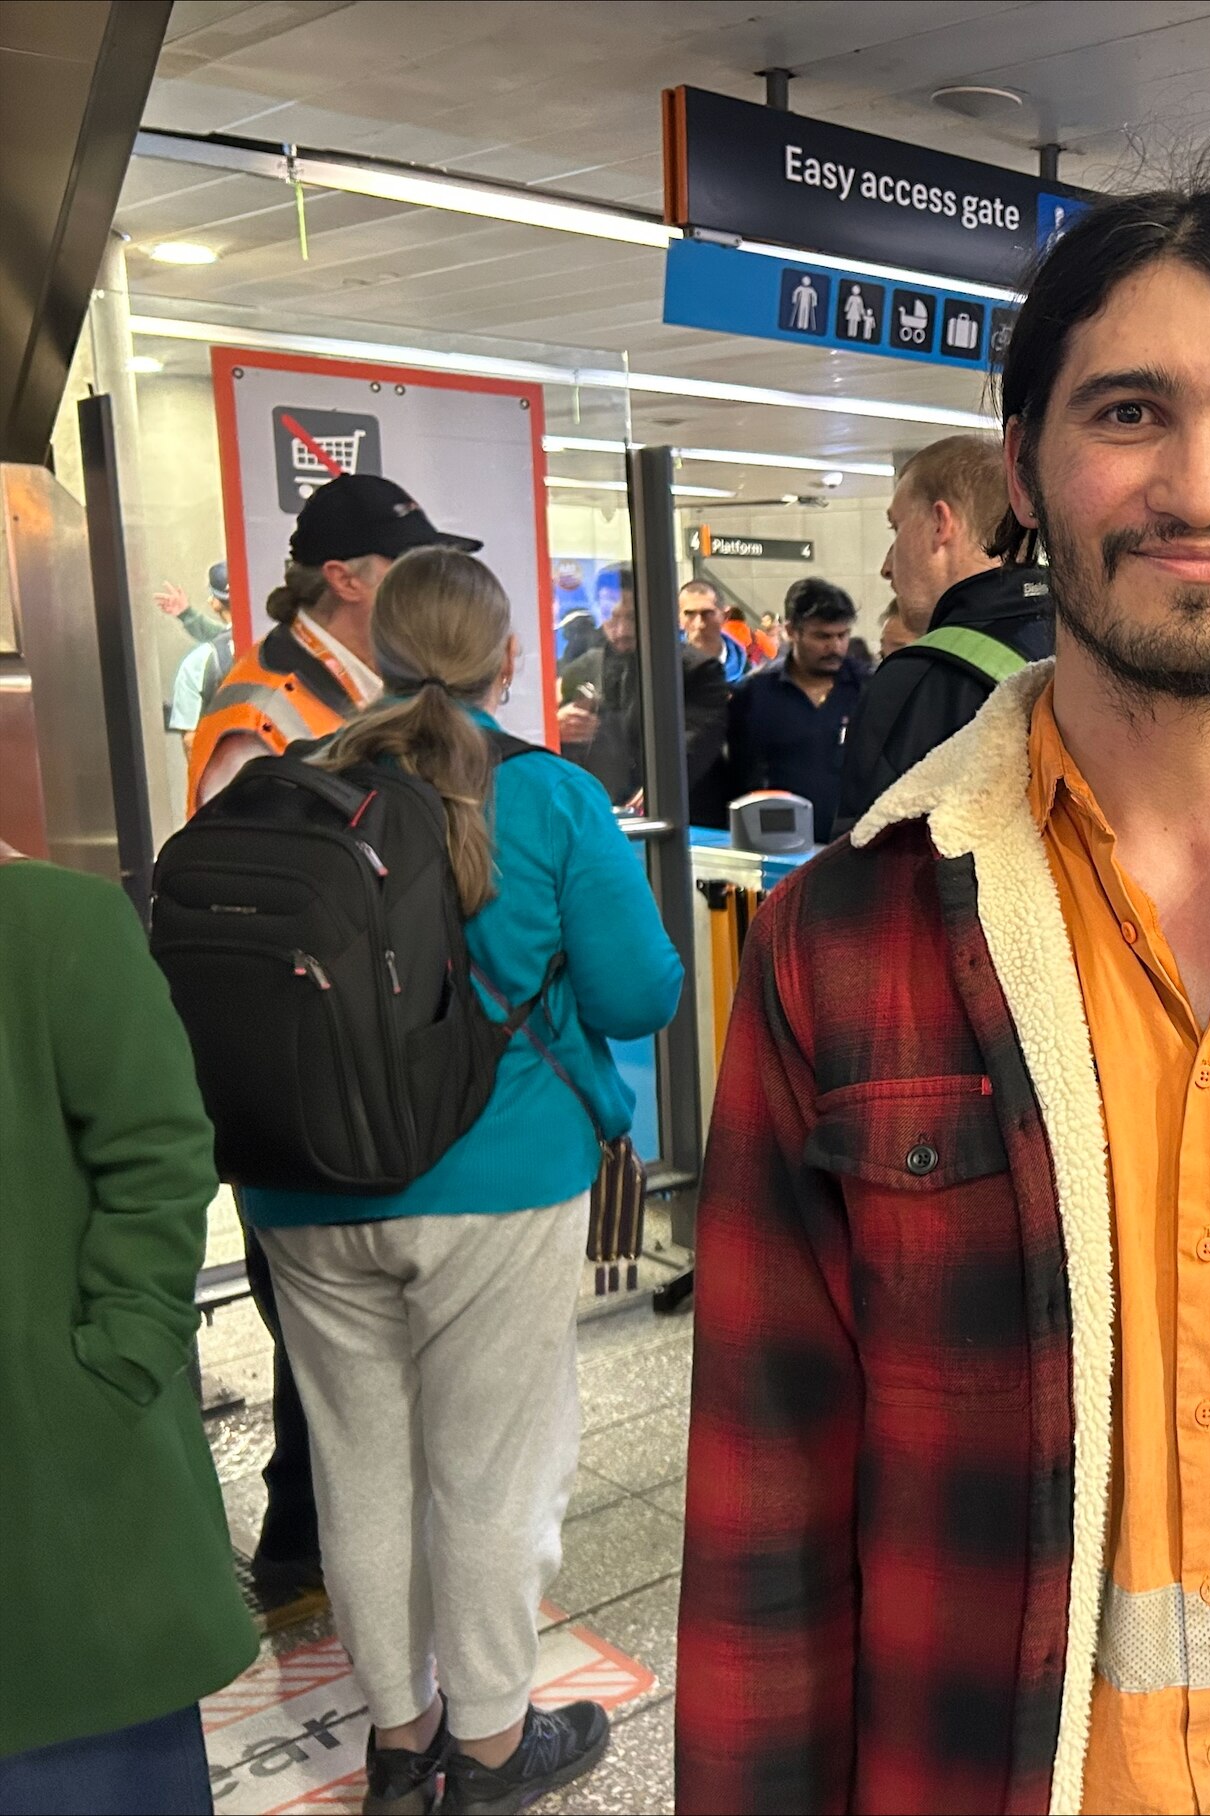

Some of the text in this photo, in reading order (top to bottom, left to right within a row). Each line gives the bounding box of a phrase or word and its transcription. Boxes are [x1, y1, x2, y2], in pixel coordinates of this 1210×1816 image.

[785, 145, 1020, 230] Easy access gate
[690, 531, 701, 551] 4
[712, 538, 811, 559] Platform 4
